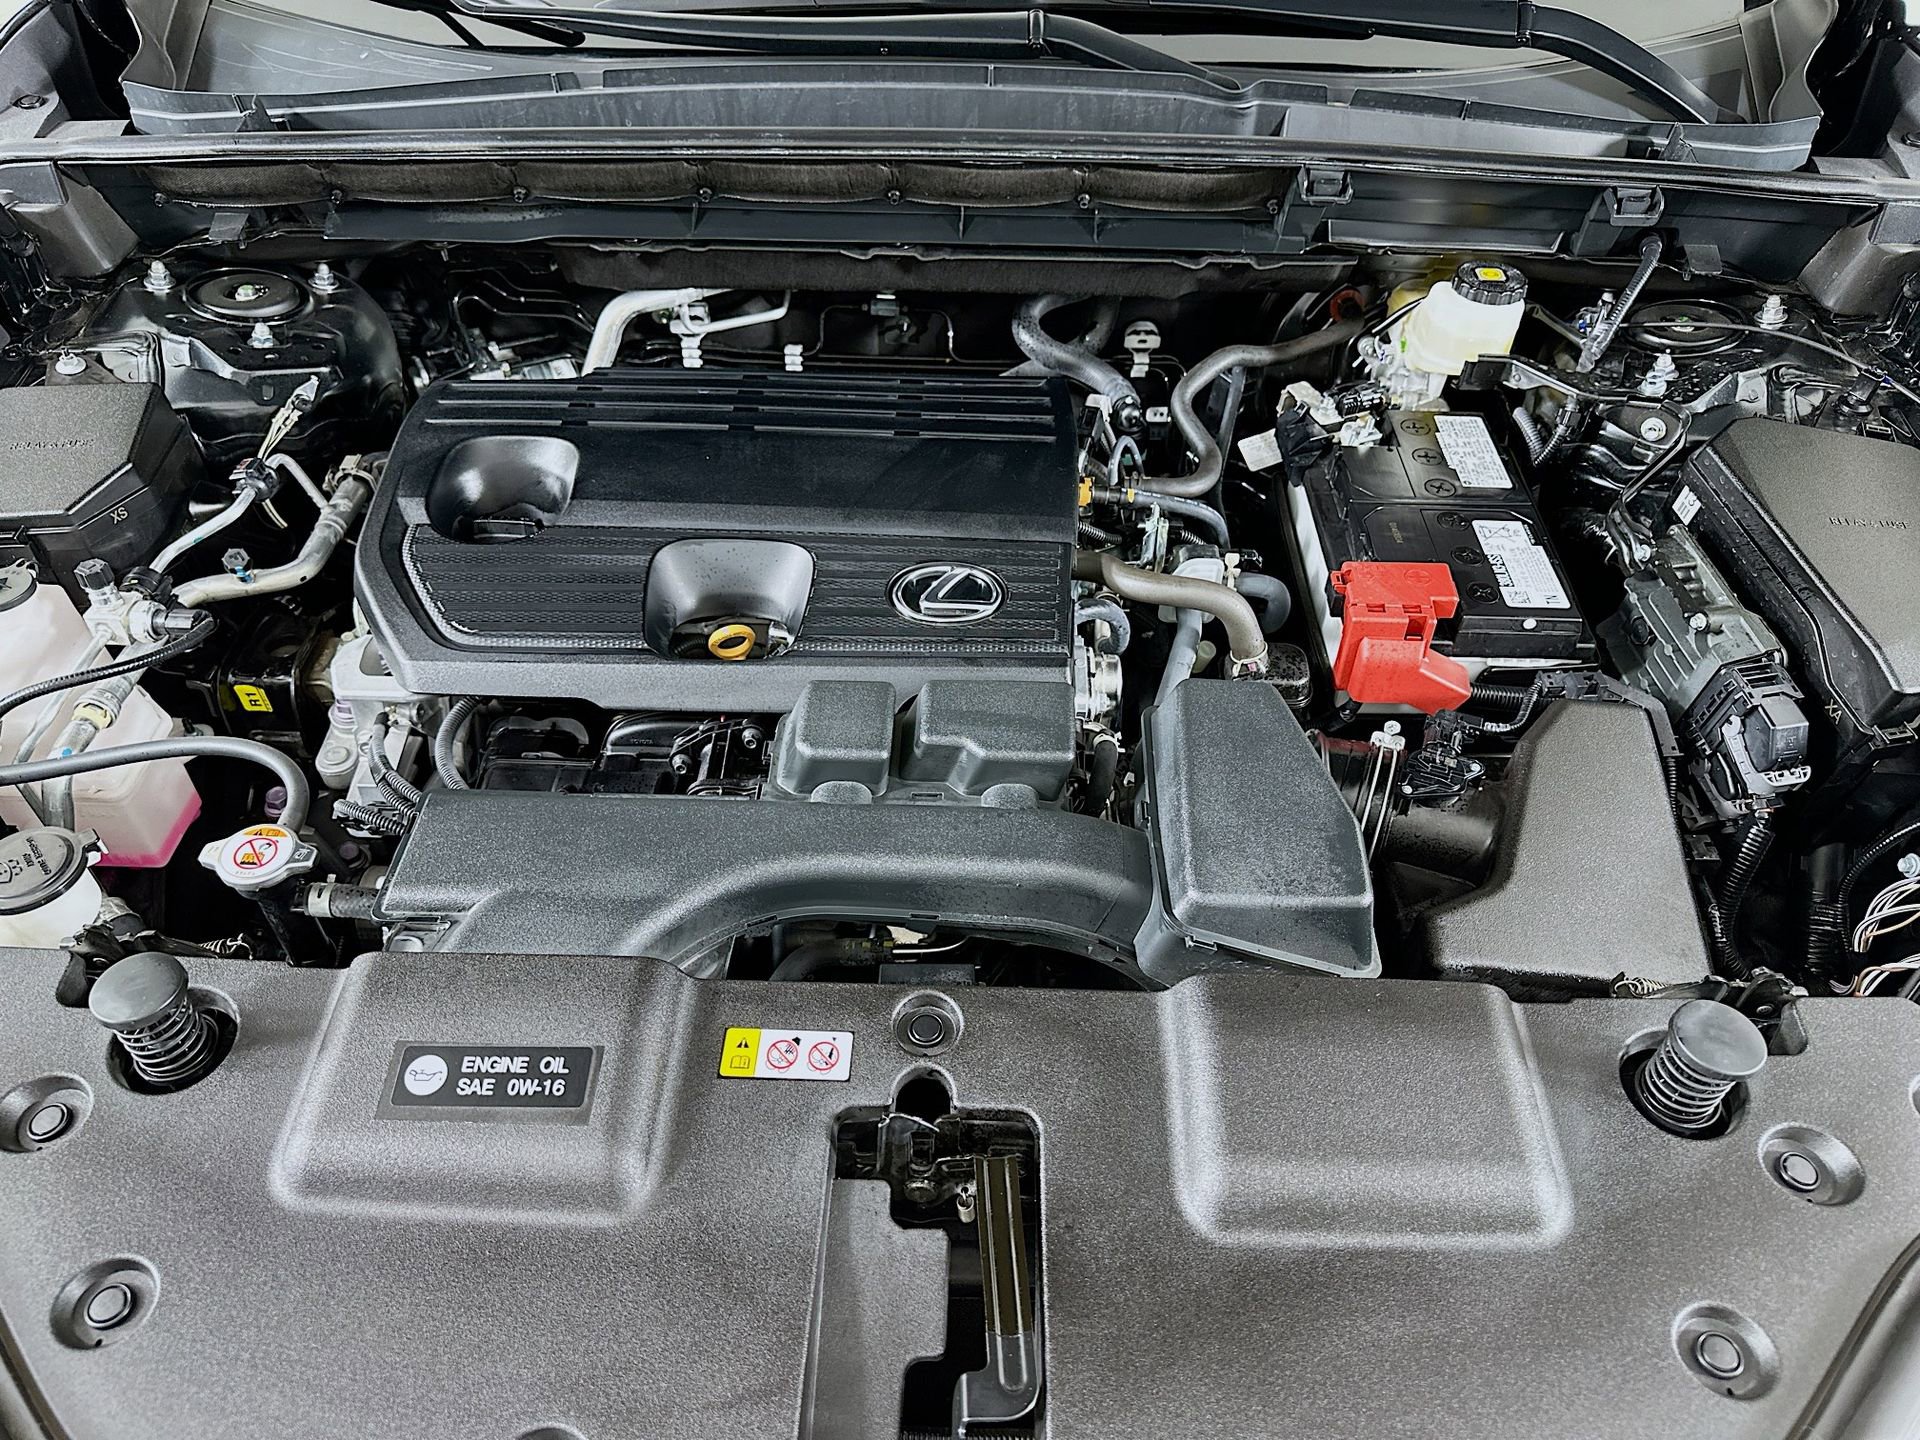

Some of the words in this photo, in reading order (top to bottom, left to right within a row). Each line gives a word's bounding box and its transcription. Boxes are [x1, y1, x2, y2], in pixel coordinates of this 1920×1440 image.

[109, 507, 129, 525] XS
[245, 692, 263, 707] R1
[1824, 698, 1843, 725] XA
[460, 1055, 530, 1073] ENGINE
[540, 1056, 569, 1074] OIL
[456, 1078, 496, 1096] SAE
[507, 1078, 566, 1096] 0W-16
